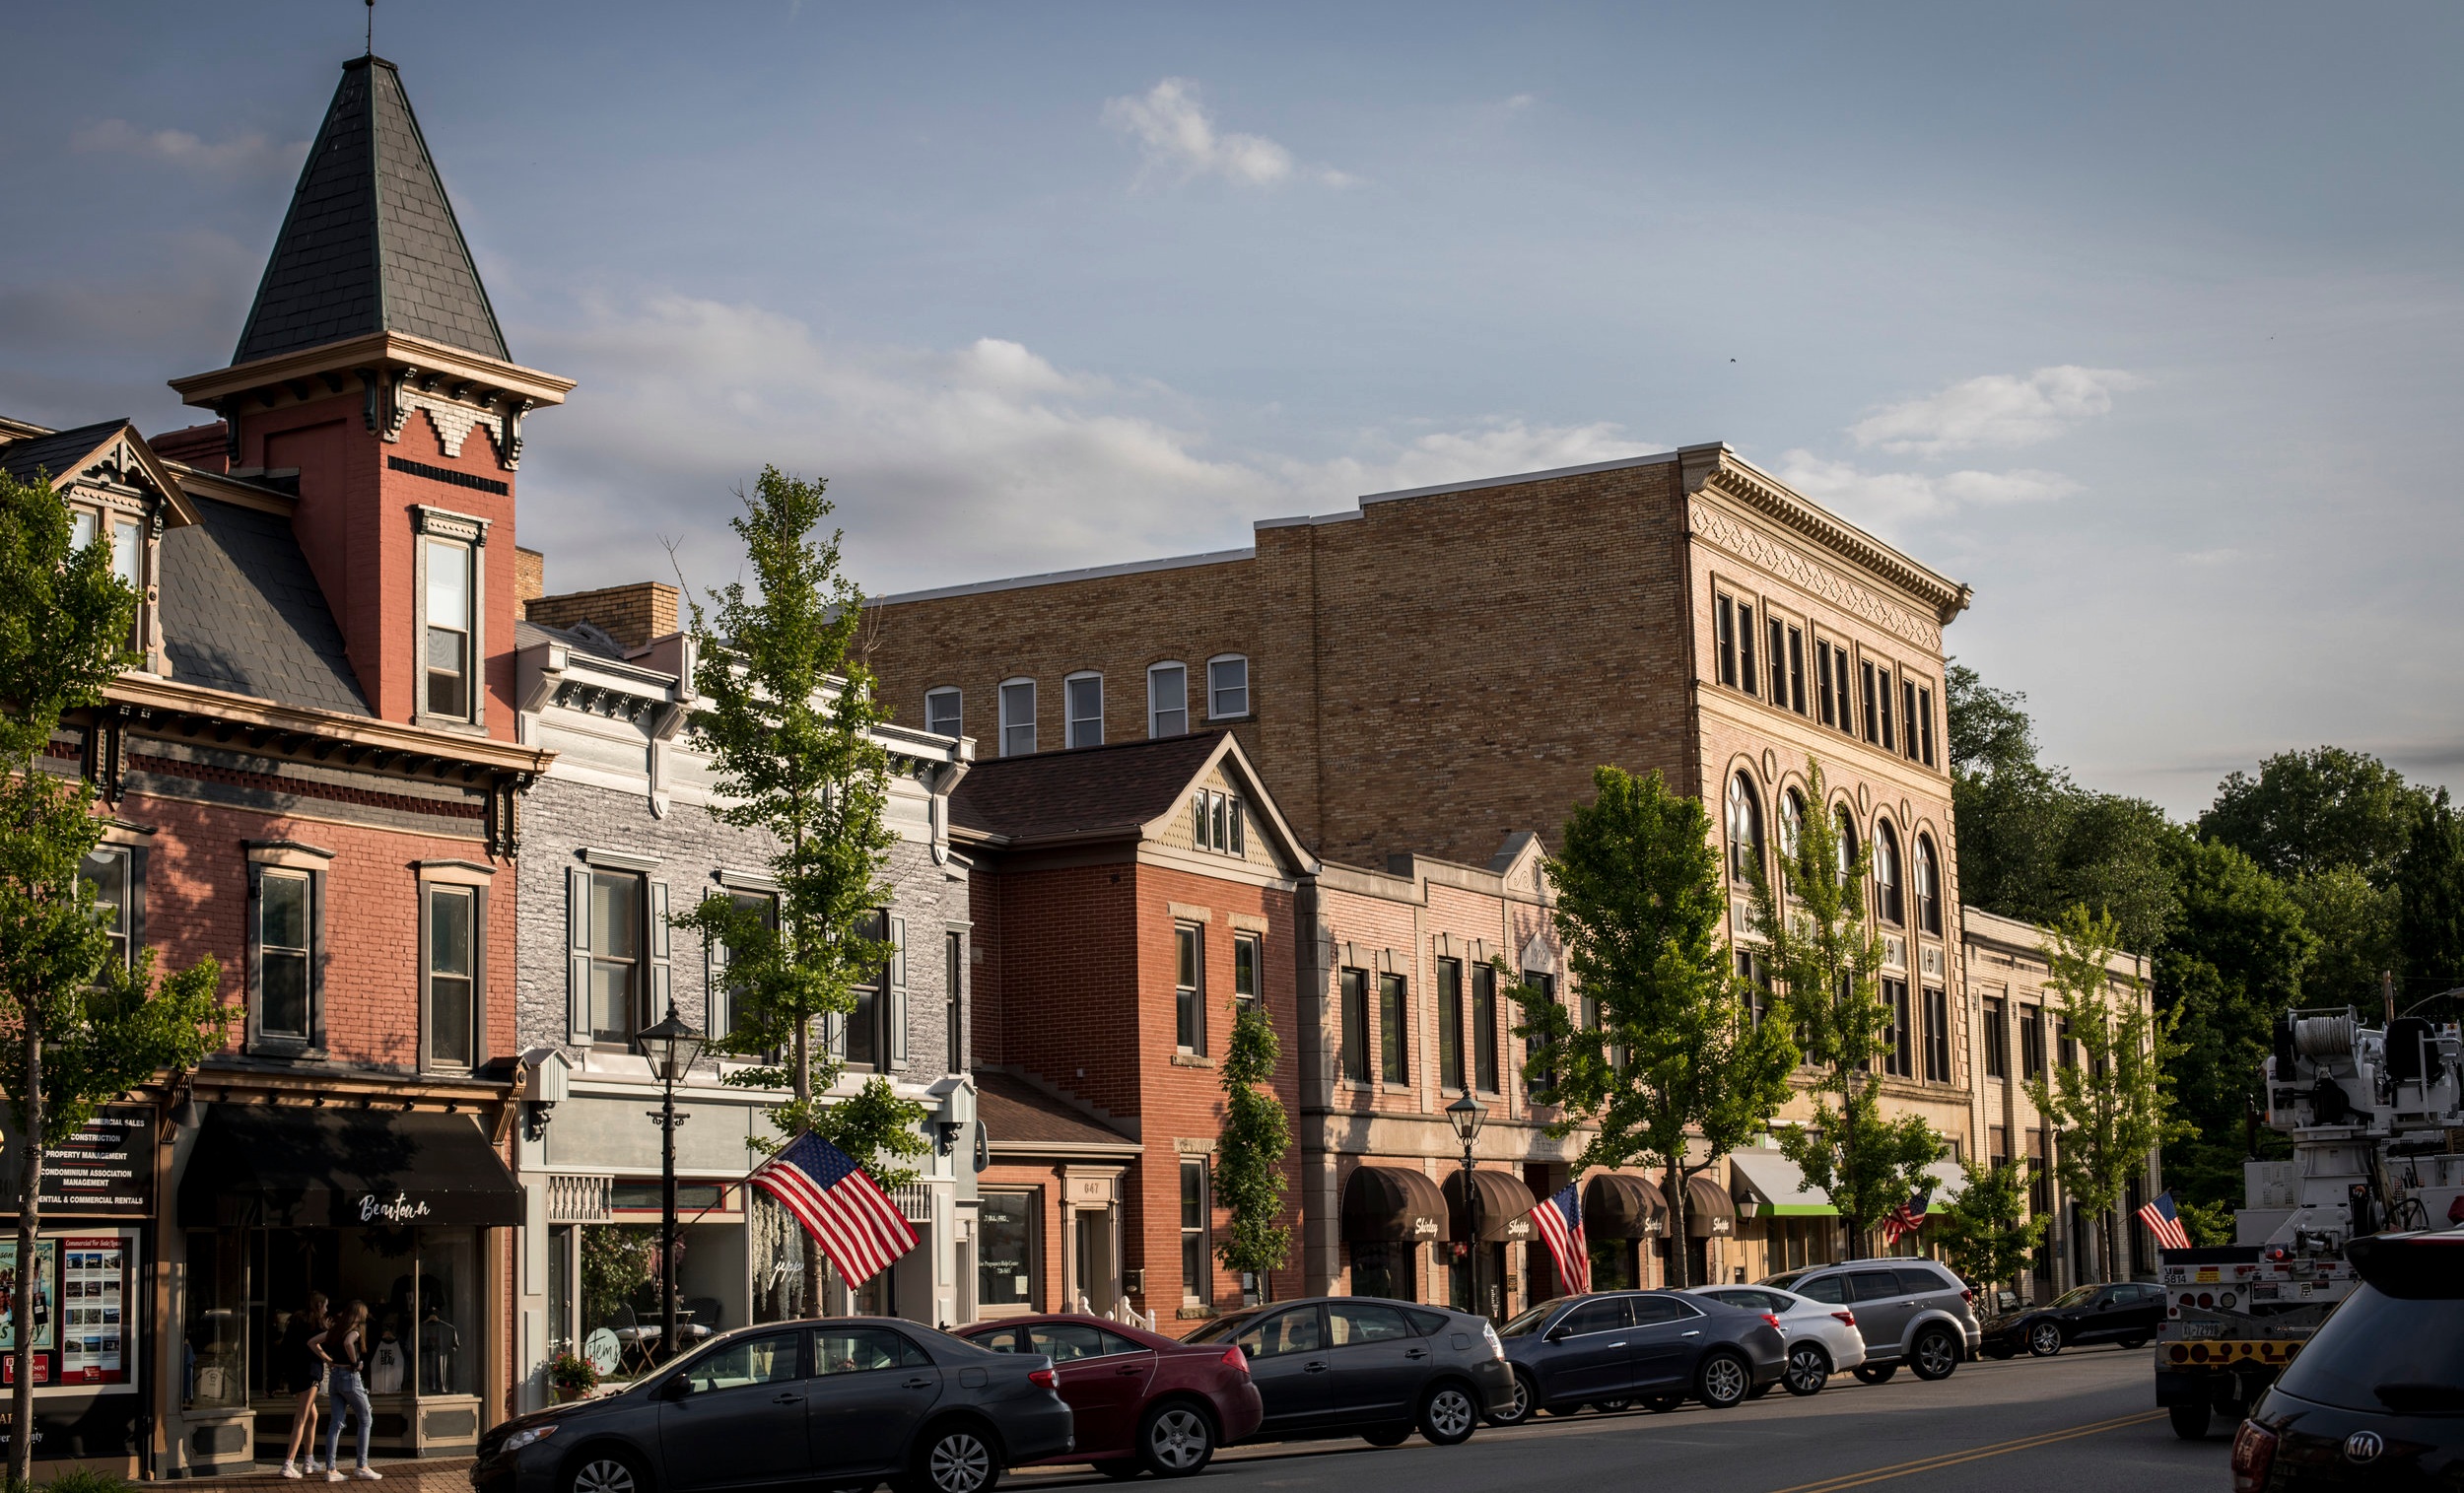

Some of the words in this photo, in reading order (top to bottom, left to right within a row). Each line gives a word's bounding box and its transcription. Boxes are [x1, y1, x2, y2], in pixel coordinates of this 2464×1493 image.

[124, 1119, 145, 1127] SALES
[70, 1133, 121, 1142] CONSTRUCTION
[81, 1151, 128, 1160] MANAGEMENT
[40, 1168, 89, 1177] CONDOMINIUM
[90, 1169, 132, 1178] ASSOCIATION
[70, 1195, 113, 1204] COMMERCIAL
[114, 1196, 144, 1205] RENTALS
[1414, 1216, 1439, 1239] Shirley
[1507, 1217, 1531, 1238] Shoppe
[1644, 1216, 1663, 1234] Shirley
[1712, 1216, 1730, 1234] Shoppe
[2163, 1274, 2186, 1283] 5814
[2347, 1436, 2374, 1458] KIA
